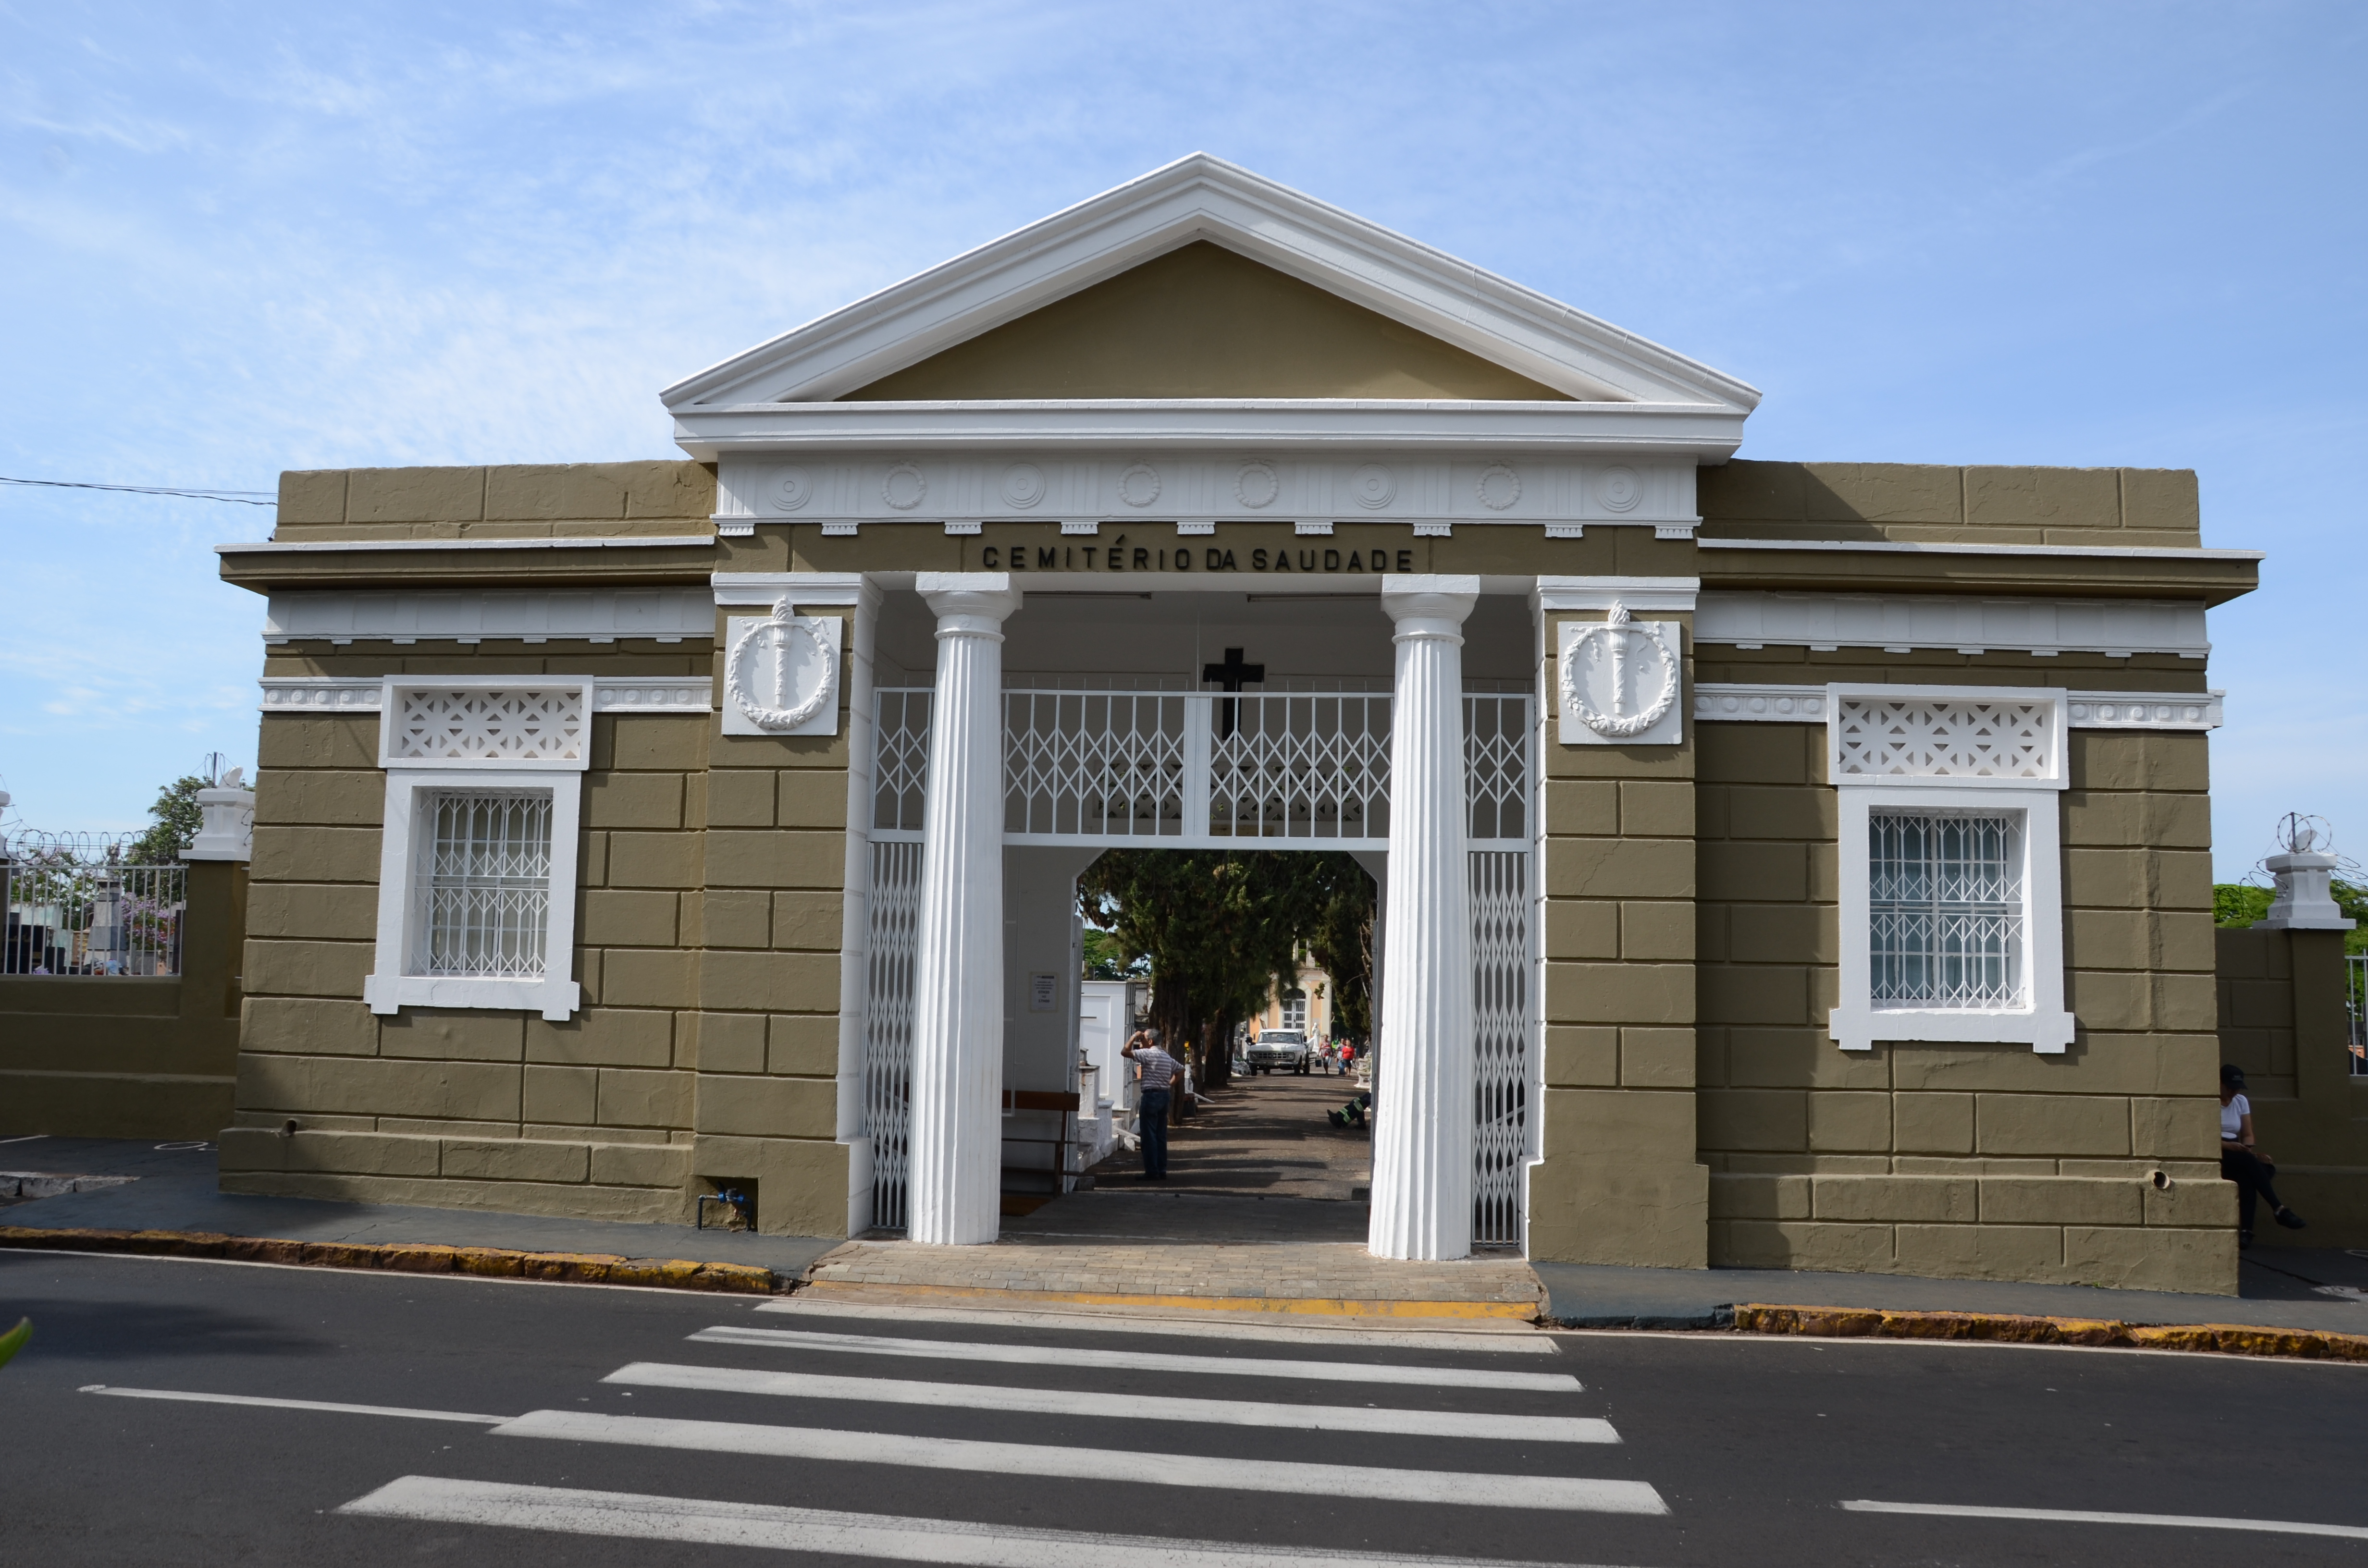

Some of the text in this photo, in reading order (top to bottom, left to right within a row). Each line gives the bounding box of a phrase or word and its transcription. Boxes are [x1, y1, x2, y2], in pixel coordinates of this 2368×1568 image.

[983, 534, 1412, 571] CEMITÉRIO DA SAUDADE
